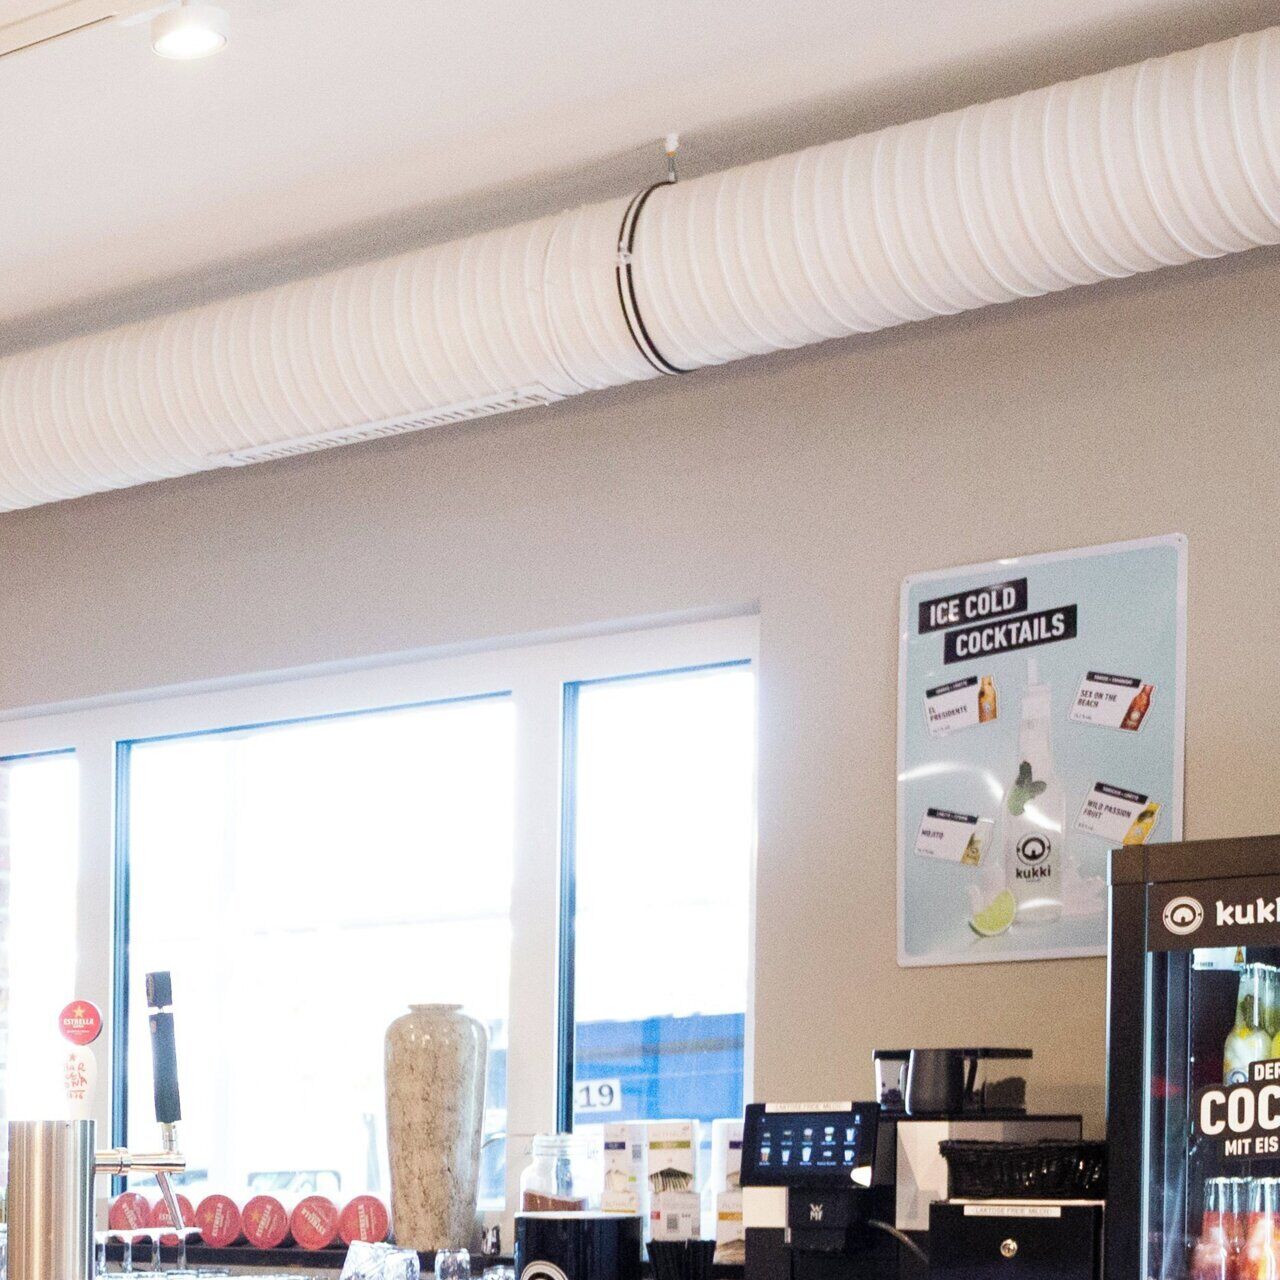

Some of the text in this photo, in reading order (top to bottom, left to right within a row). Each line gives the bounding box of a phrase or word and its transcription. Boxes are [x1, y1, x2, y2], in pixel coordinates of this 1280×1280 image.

[930, 586, 1016, 627] ICE COLD
[955, 612, 1065, 657] COCKTAILS
[1077, 698, 1099, 708] BEACH
[1081, 689, 1118, 702] SEX ON THE
[1016, 864, 1051, 880] kukki
[1225, 1136, 1279, 1157] MIT EIS
